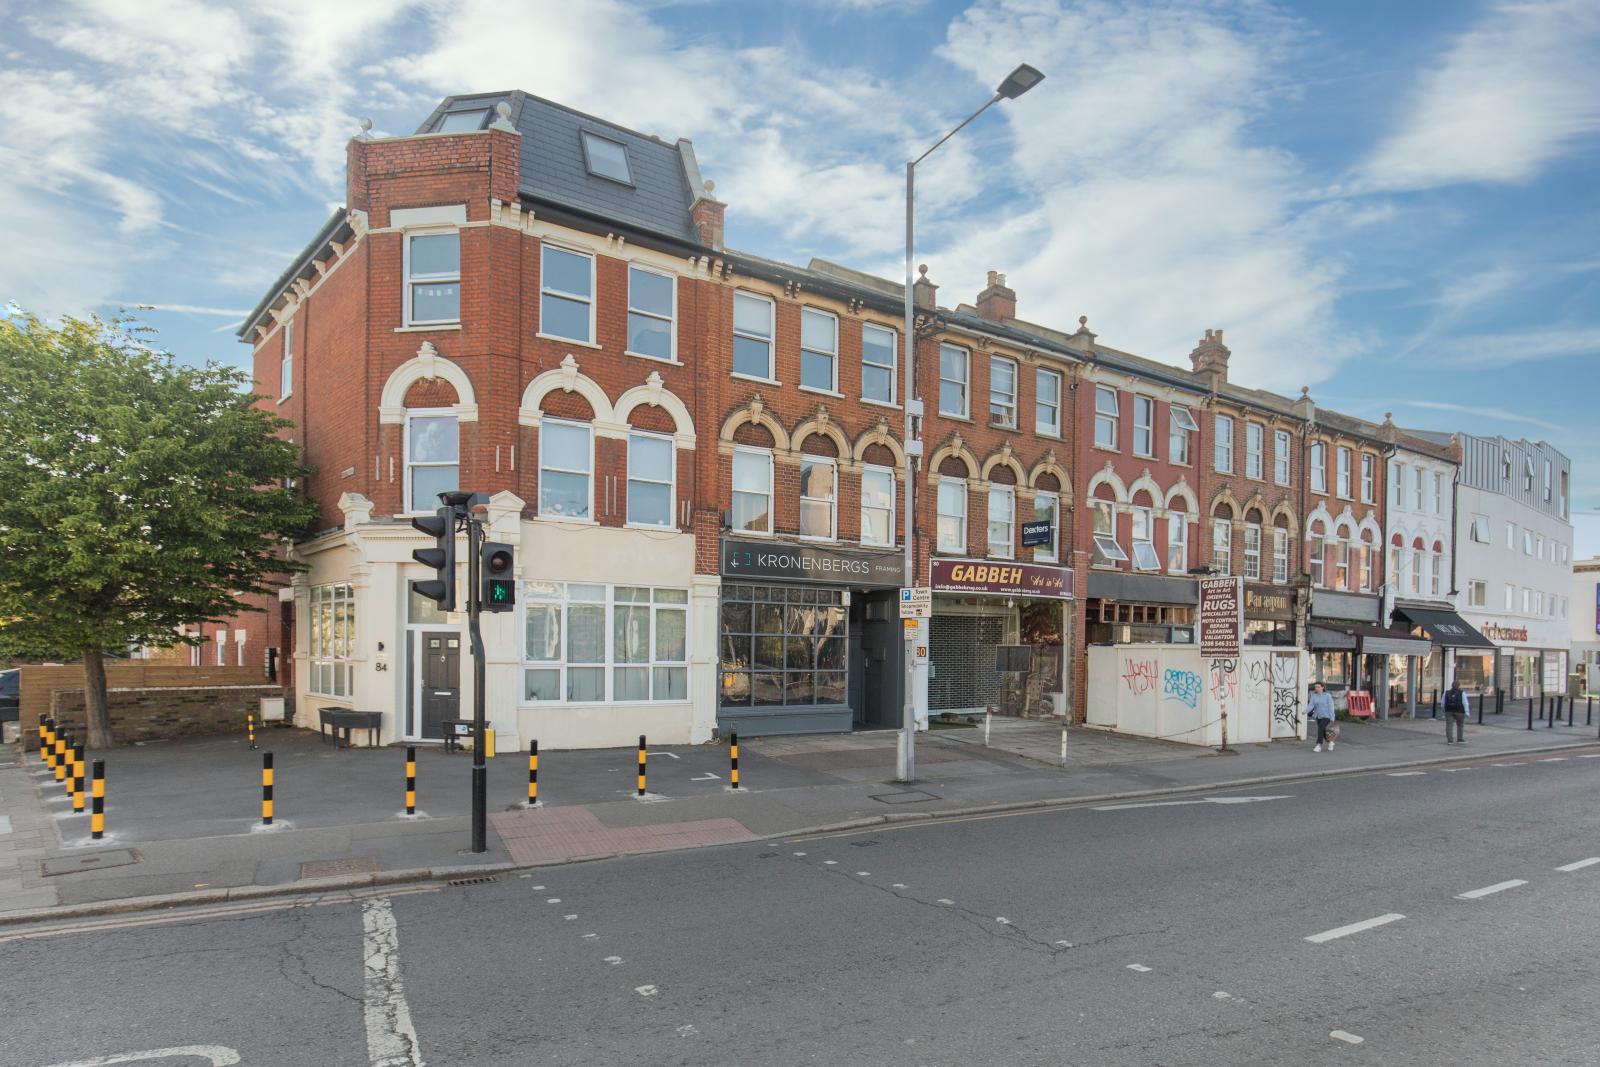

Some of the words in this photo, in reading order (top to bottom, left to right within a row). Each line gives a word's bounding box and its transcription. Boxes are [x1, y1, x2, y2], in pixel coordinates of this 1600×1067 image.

[1023, 525, 1049, 535] Dexters
[757, 553, 870, 574] KRONENBERGS
[875, 565, 901, 574] FRAMING
[951, 565, 1023, 584] GABBEH
[1202, 579, 1236, 589] GABBEH
[1203, 600, 1235, 611] RUGS
[375, 662, 387, 671] 84
